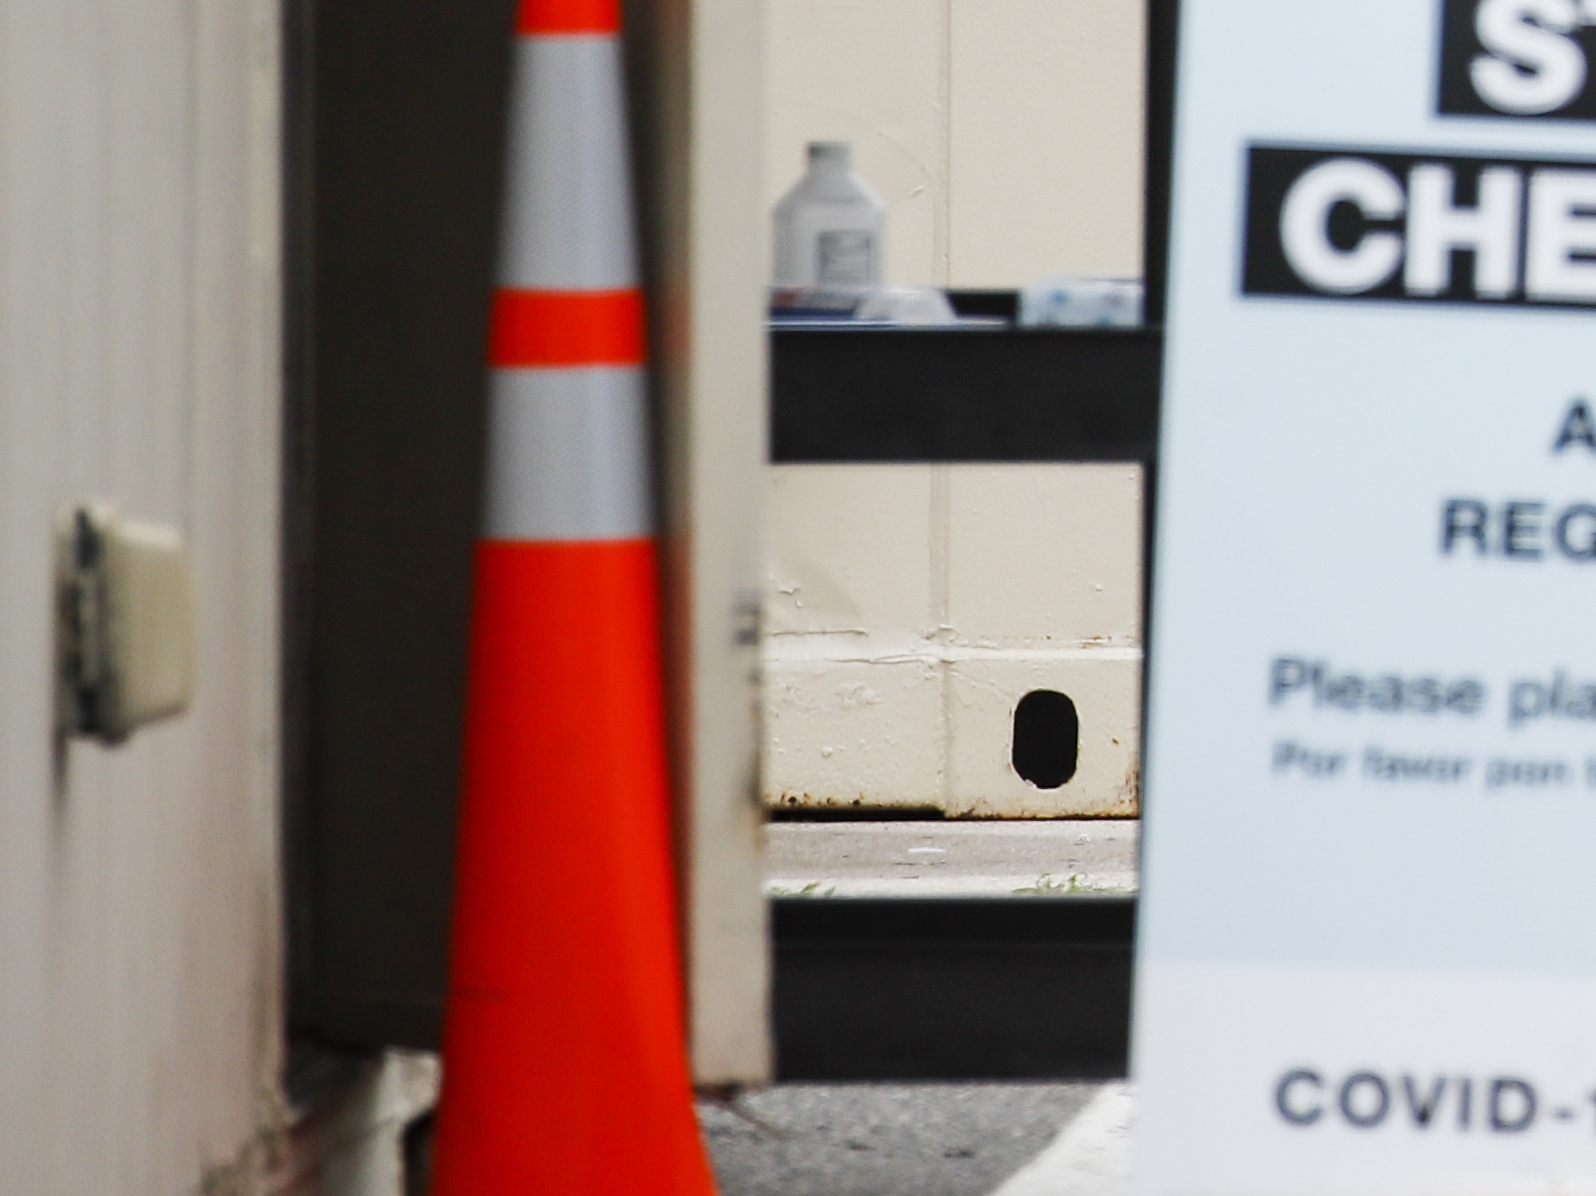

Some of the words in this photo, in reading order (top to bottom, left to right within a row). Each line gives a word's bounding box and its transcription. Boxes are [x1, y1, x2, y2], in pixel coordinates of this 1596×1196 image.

[1268, 655, 1486, 716] Please
[1270, 739, 1346, 780] Por
[1361, 744, 1471, 782] favor
